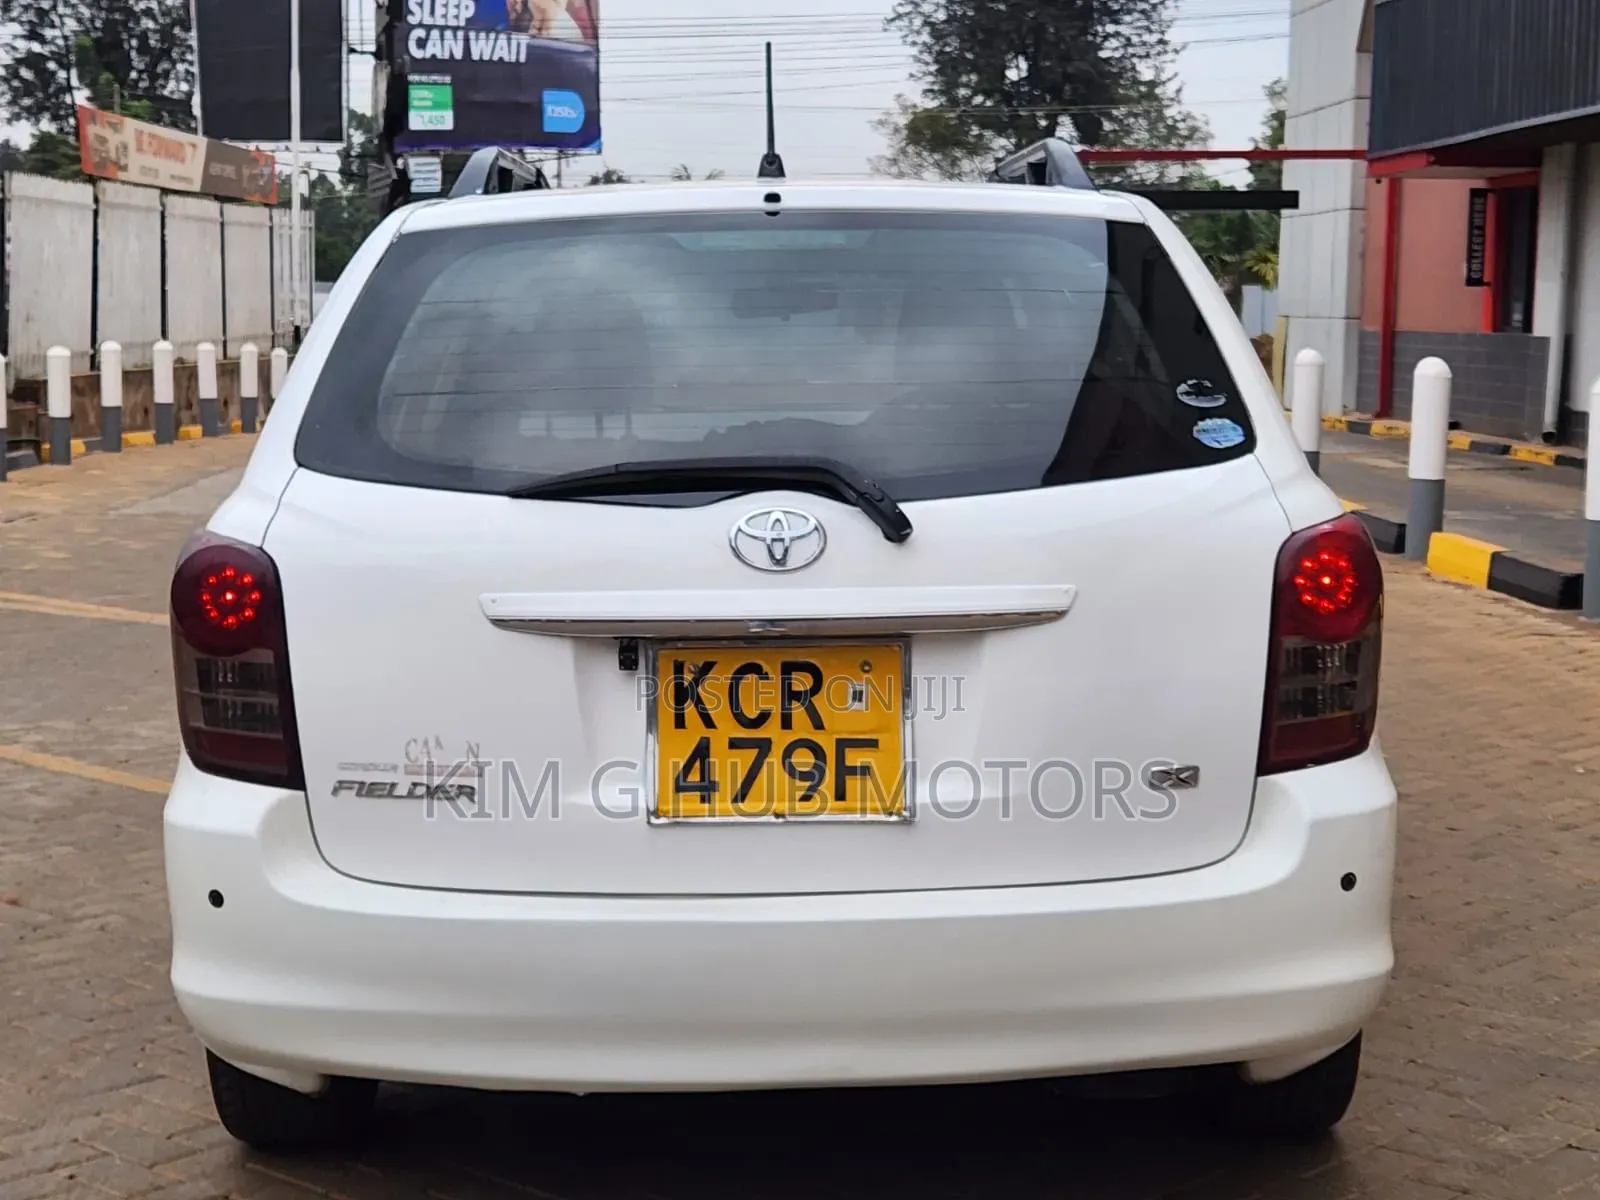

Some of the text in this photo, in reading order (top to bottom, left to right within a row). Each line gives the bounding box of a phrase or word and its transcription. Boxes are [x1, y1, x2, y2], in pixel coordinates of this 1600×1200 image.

[407, 0, 475, 26] SLEEP
[408, 28, 530, 63] CAN WAIT
[672, 660, 826, 731] KCR
[674, 736, 880, 805] 479F
[331, 780, 477, 804] FIELDER
